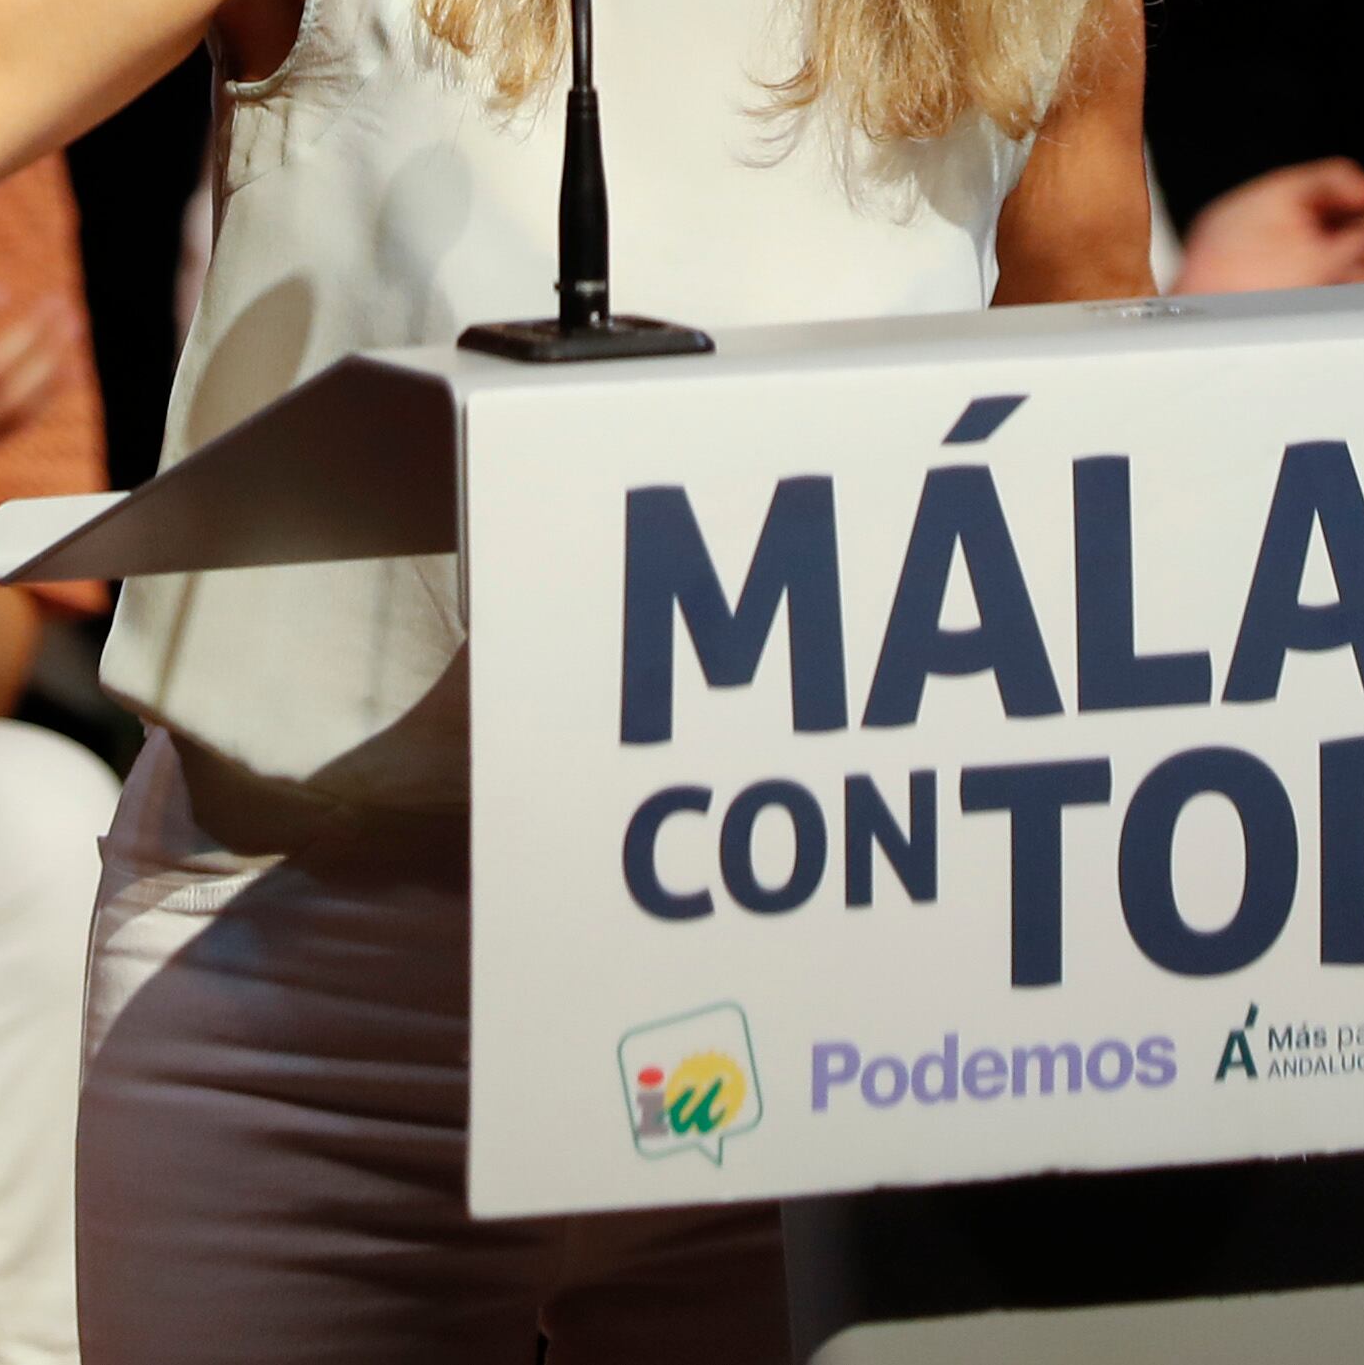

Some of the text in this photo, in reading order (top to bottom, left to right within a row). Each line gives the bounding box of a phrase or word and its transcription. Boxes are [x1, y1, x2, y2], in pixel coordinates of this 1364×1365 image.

[622, 769, 937, 922] CON
[811, 1032, 1177, 1113] Podemos
[1268, 1021, 1327, 1054] Más
